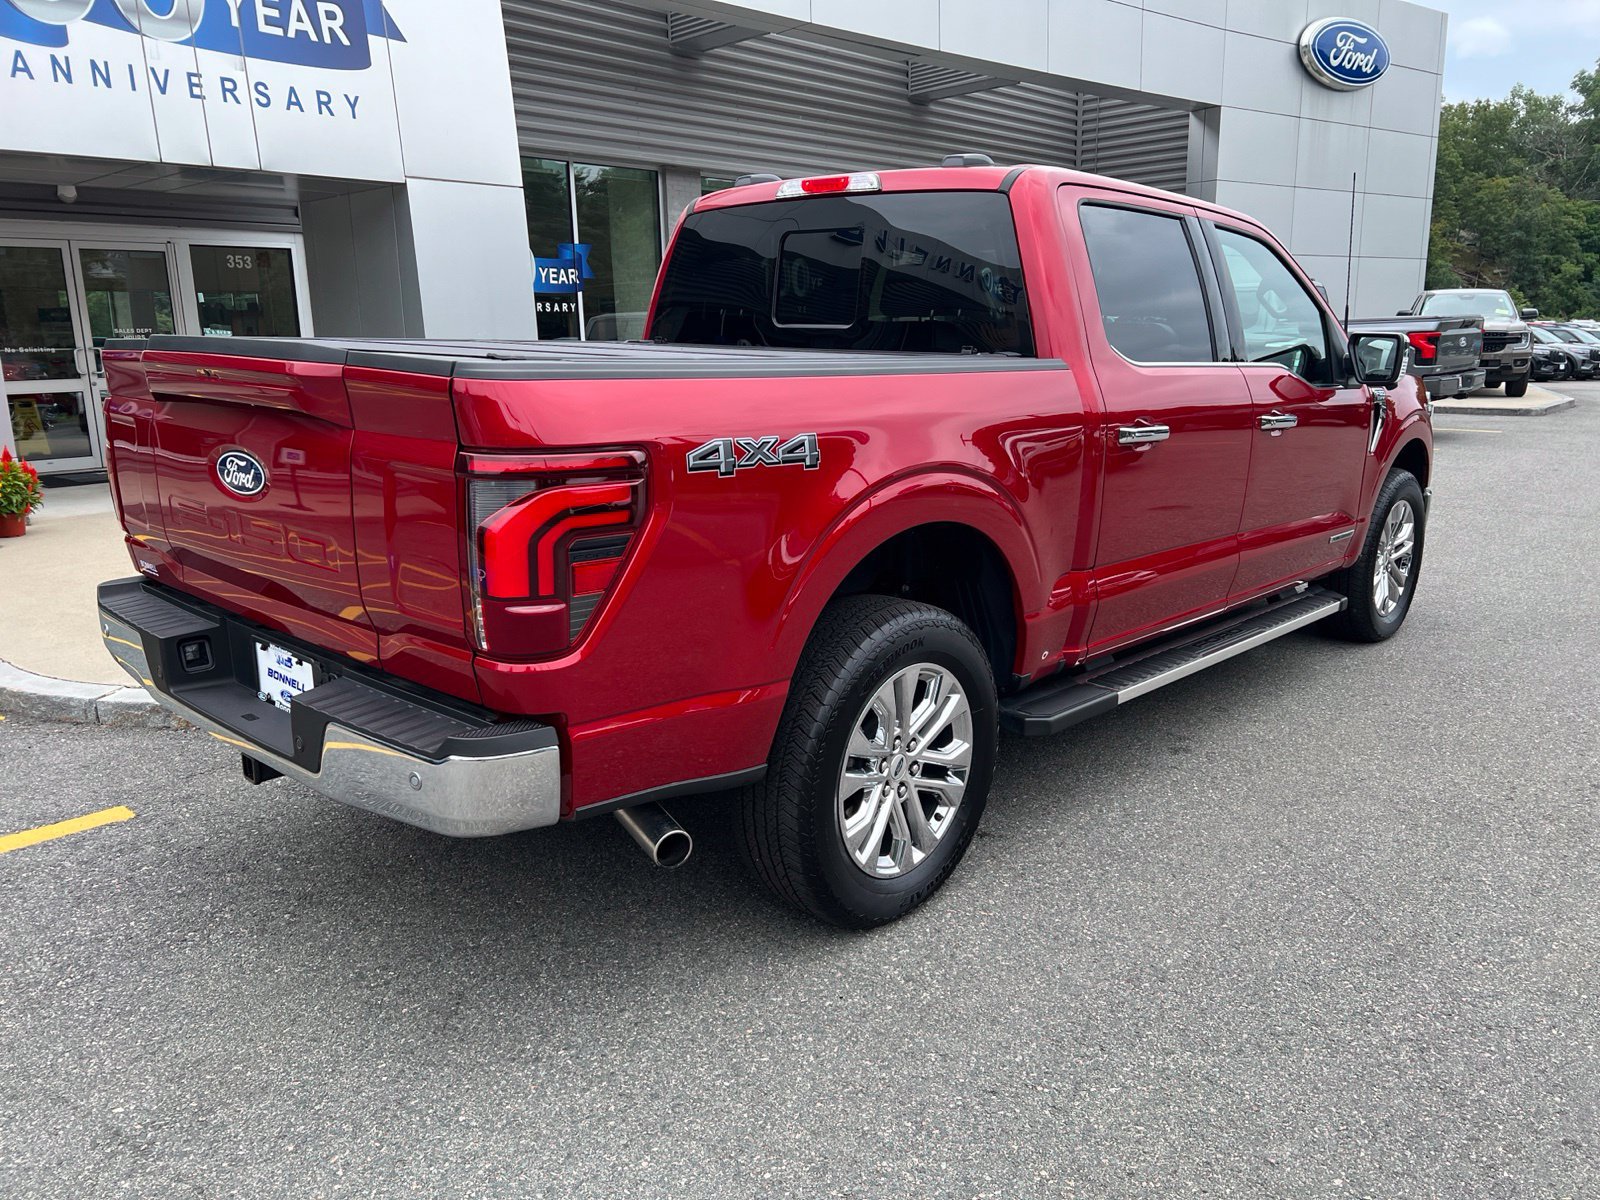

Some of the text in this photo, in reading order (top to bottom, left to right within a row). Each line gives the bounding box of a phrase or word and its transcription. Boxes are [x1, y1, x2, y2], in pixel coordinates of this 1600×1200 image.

[225, 0, 351, 46] YEAR
[1329, 31, 1378, 74] Ford
[10, 50, 360, 119] ANNIVERSARY
[226, 254, 252, 269] 353
[538, 266, 580, 285] YEAR
[536, 302, 576, 313] RSARY
[224, 456, 255, 489] Ford
[169, 494, 341, 573] F-150
[267, 667, 305, 693] BONNELL
